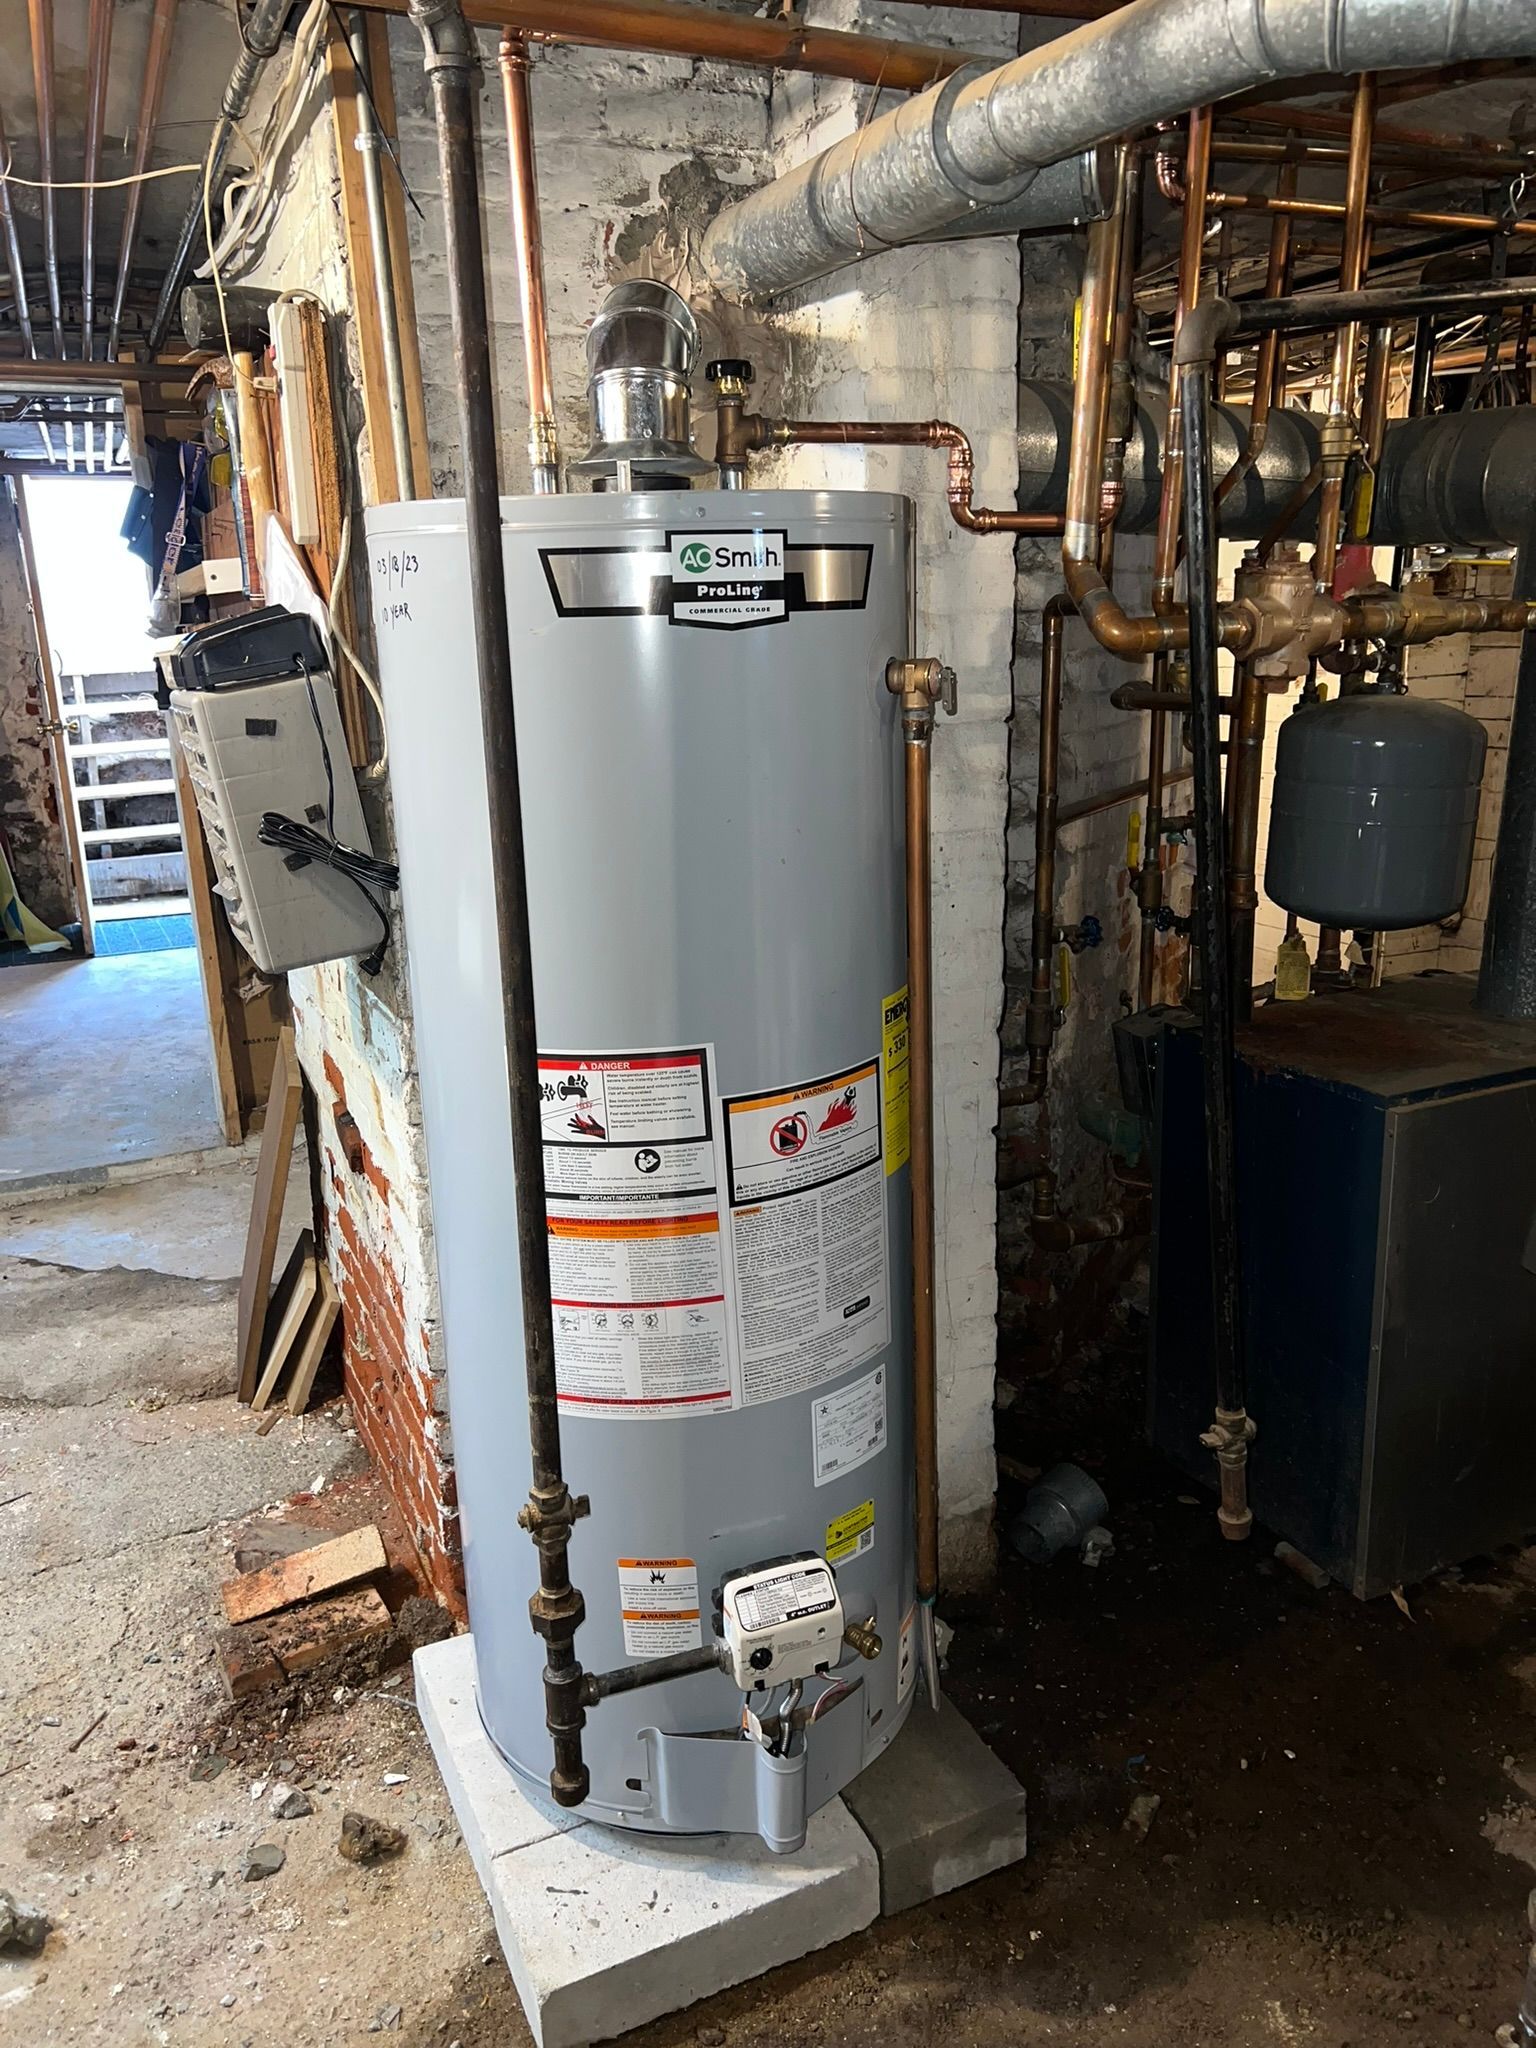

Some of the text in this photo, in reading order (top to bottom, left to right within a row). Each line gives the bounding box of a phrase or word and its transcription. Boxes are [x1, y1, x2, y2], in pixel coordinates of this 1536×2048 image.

[682, 548, 714, 569] AO
[390, 602, 412, 630] YEAR
[591, 1062, 630, 1070] DANGER
[801, 1083, 834, 1098] WARNING
[753, 1580, 774, 1590] STATUS
[775, 1575, 790, 1584] LIGHT
[792, 1572, 806, 1580] CODE
[808, 1603, 827, 1612] OUTLET
